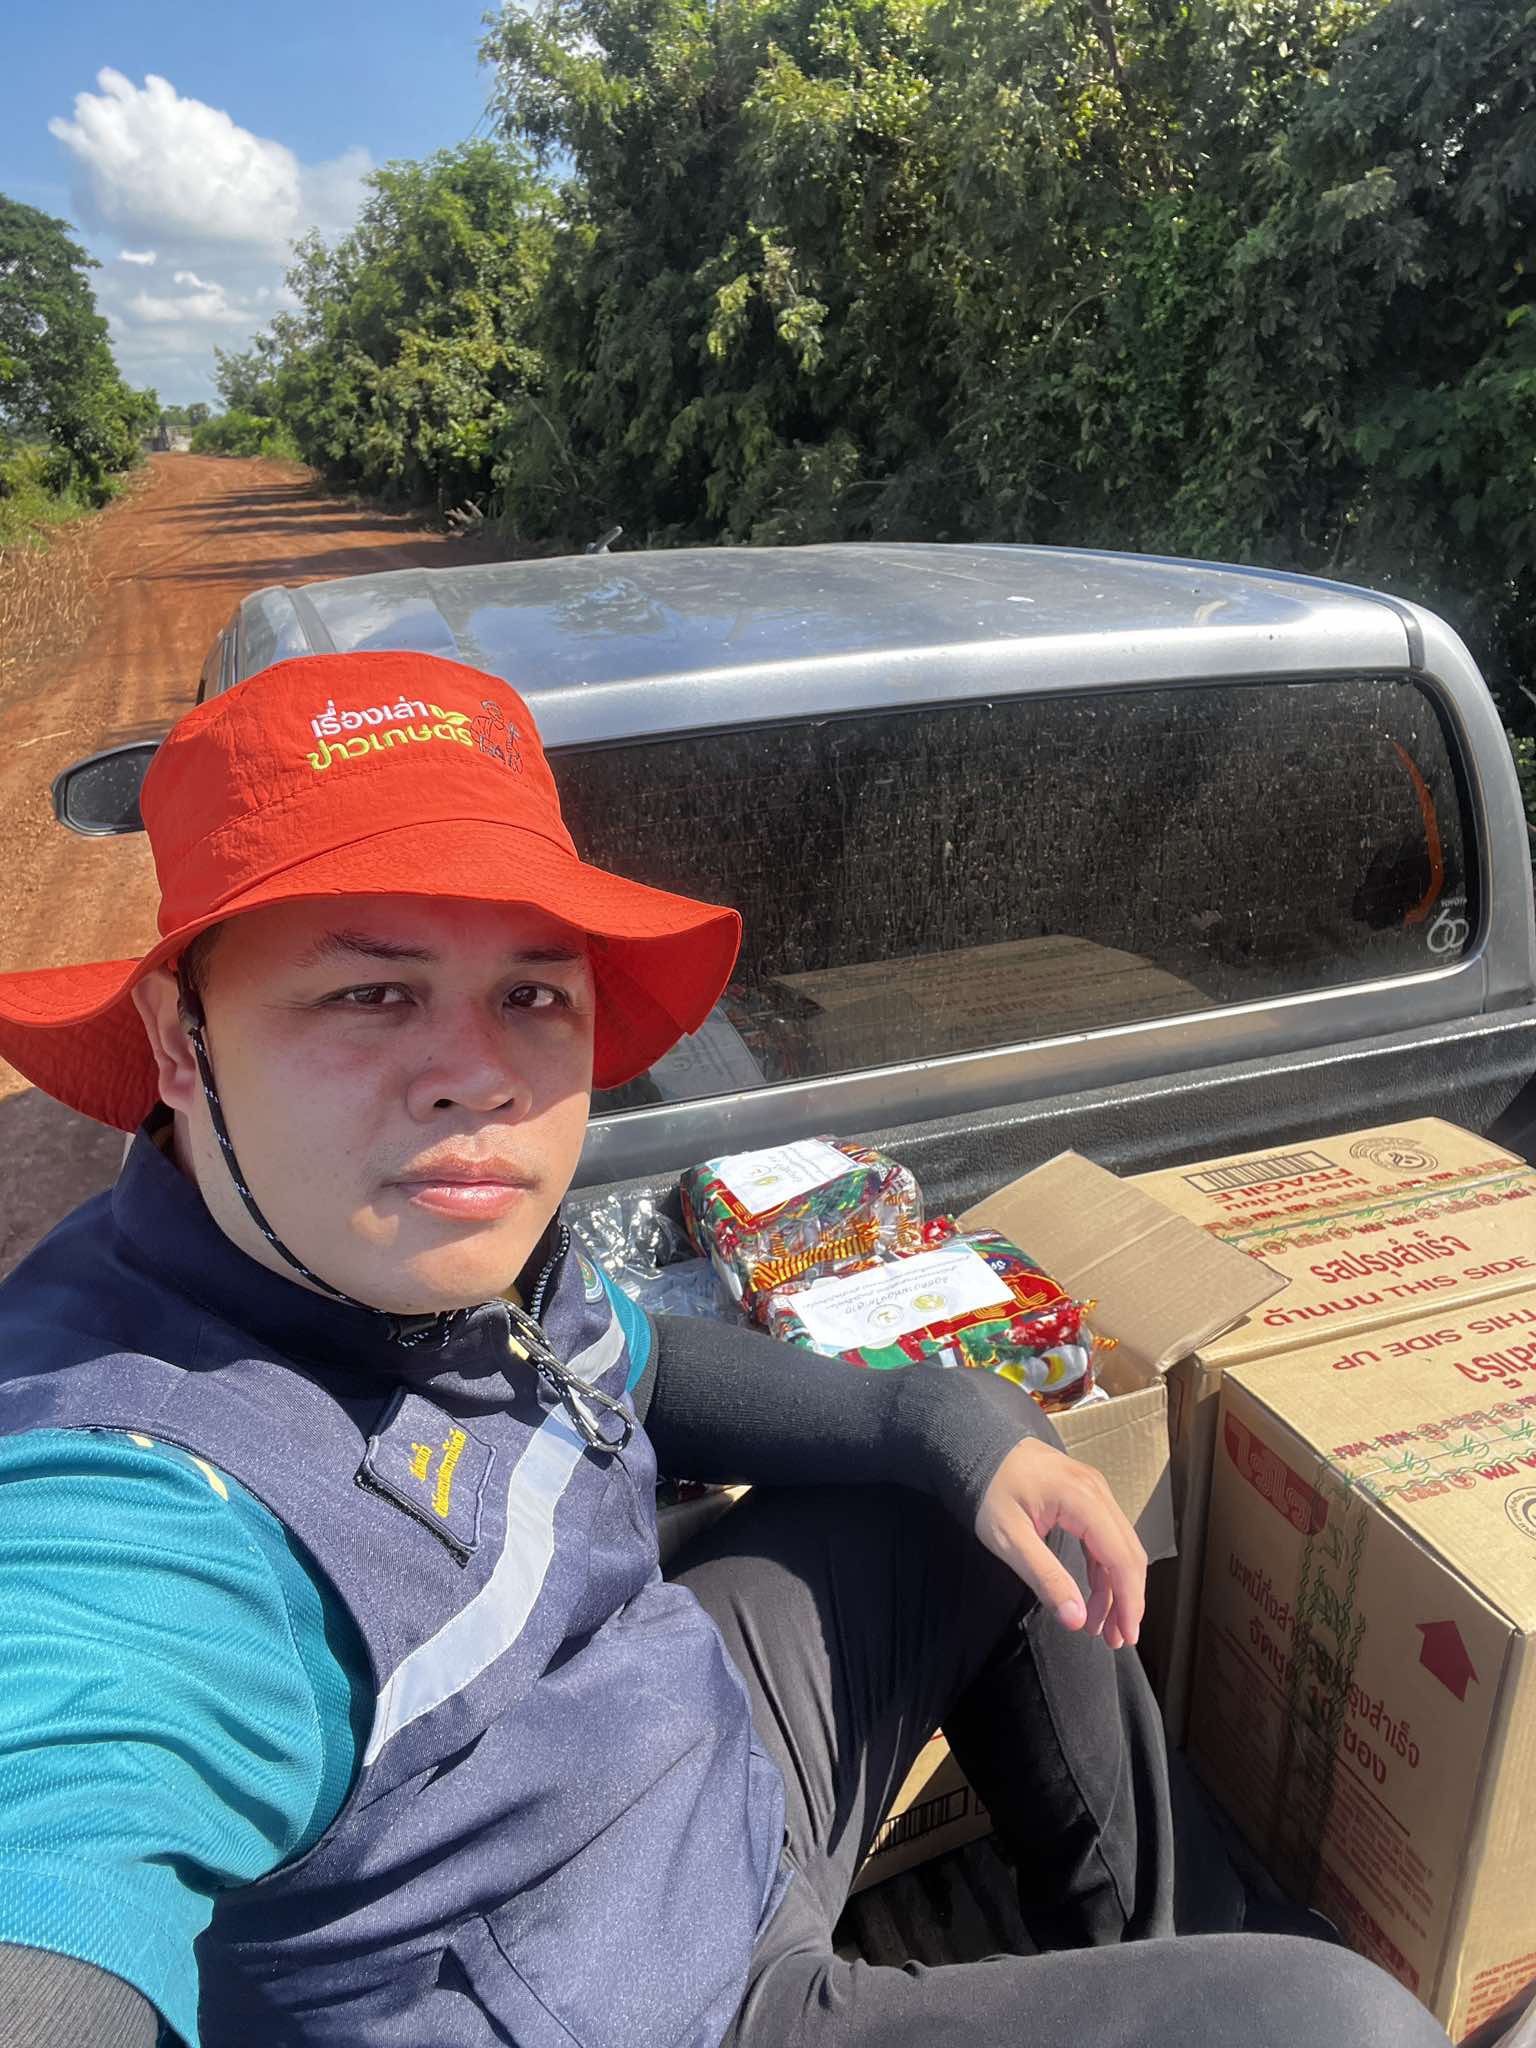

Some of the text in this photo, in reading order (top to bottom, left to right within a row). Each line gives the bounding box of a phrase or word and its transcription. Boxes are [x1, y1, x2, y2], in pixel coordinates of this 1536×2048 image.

[310, 695, 430, 738] เรื่องเล่า
[1426, 908, 1470, 953] 60
[1211, 1167, 1353, 1203] FRAGILE
[1309, 1230, 1472, 1285] รสปรุงสำเร็จ
[1263, 1254, 1535, 1328] ด้านบน THIS SIDE
[1332, 1349, 1382, 1371] UP
[1382, 1328, 1463, 1358] SIDE
[1473, 1459, 1520, 1481] WAI
